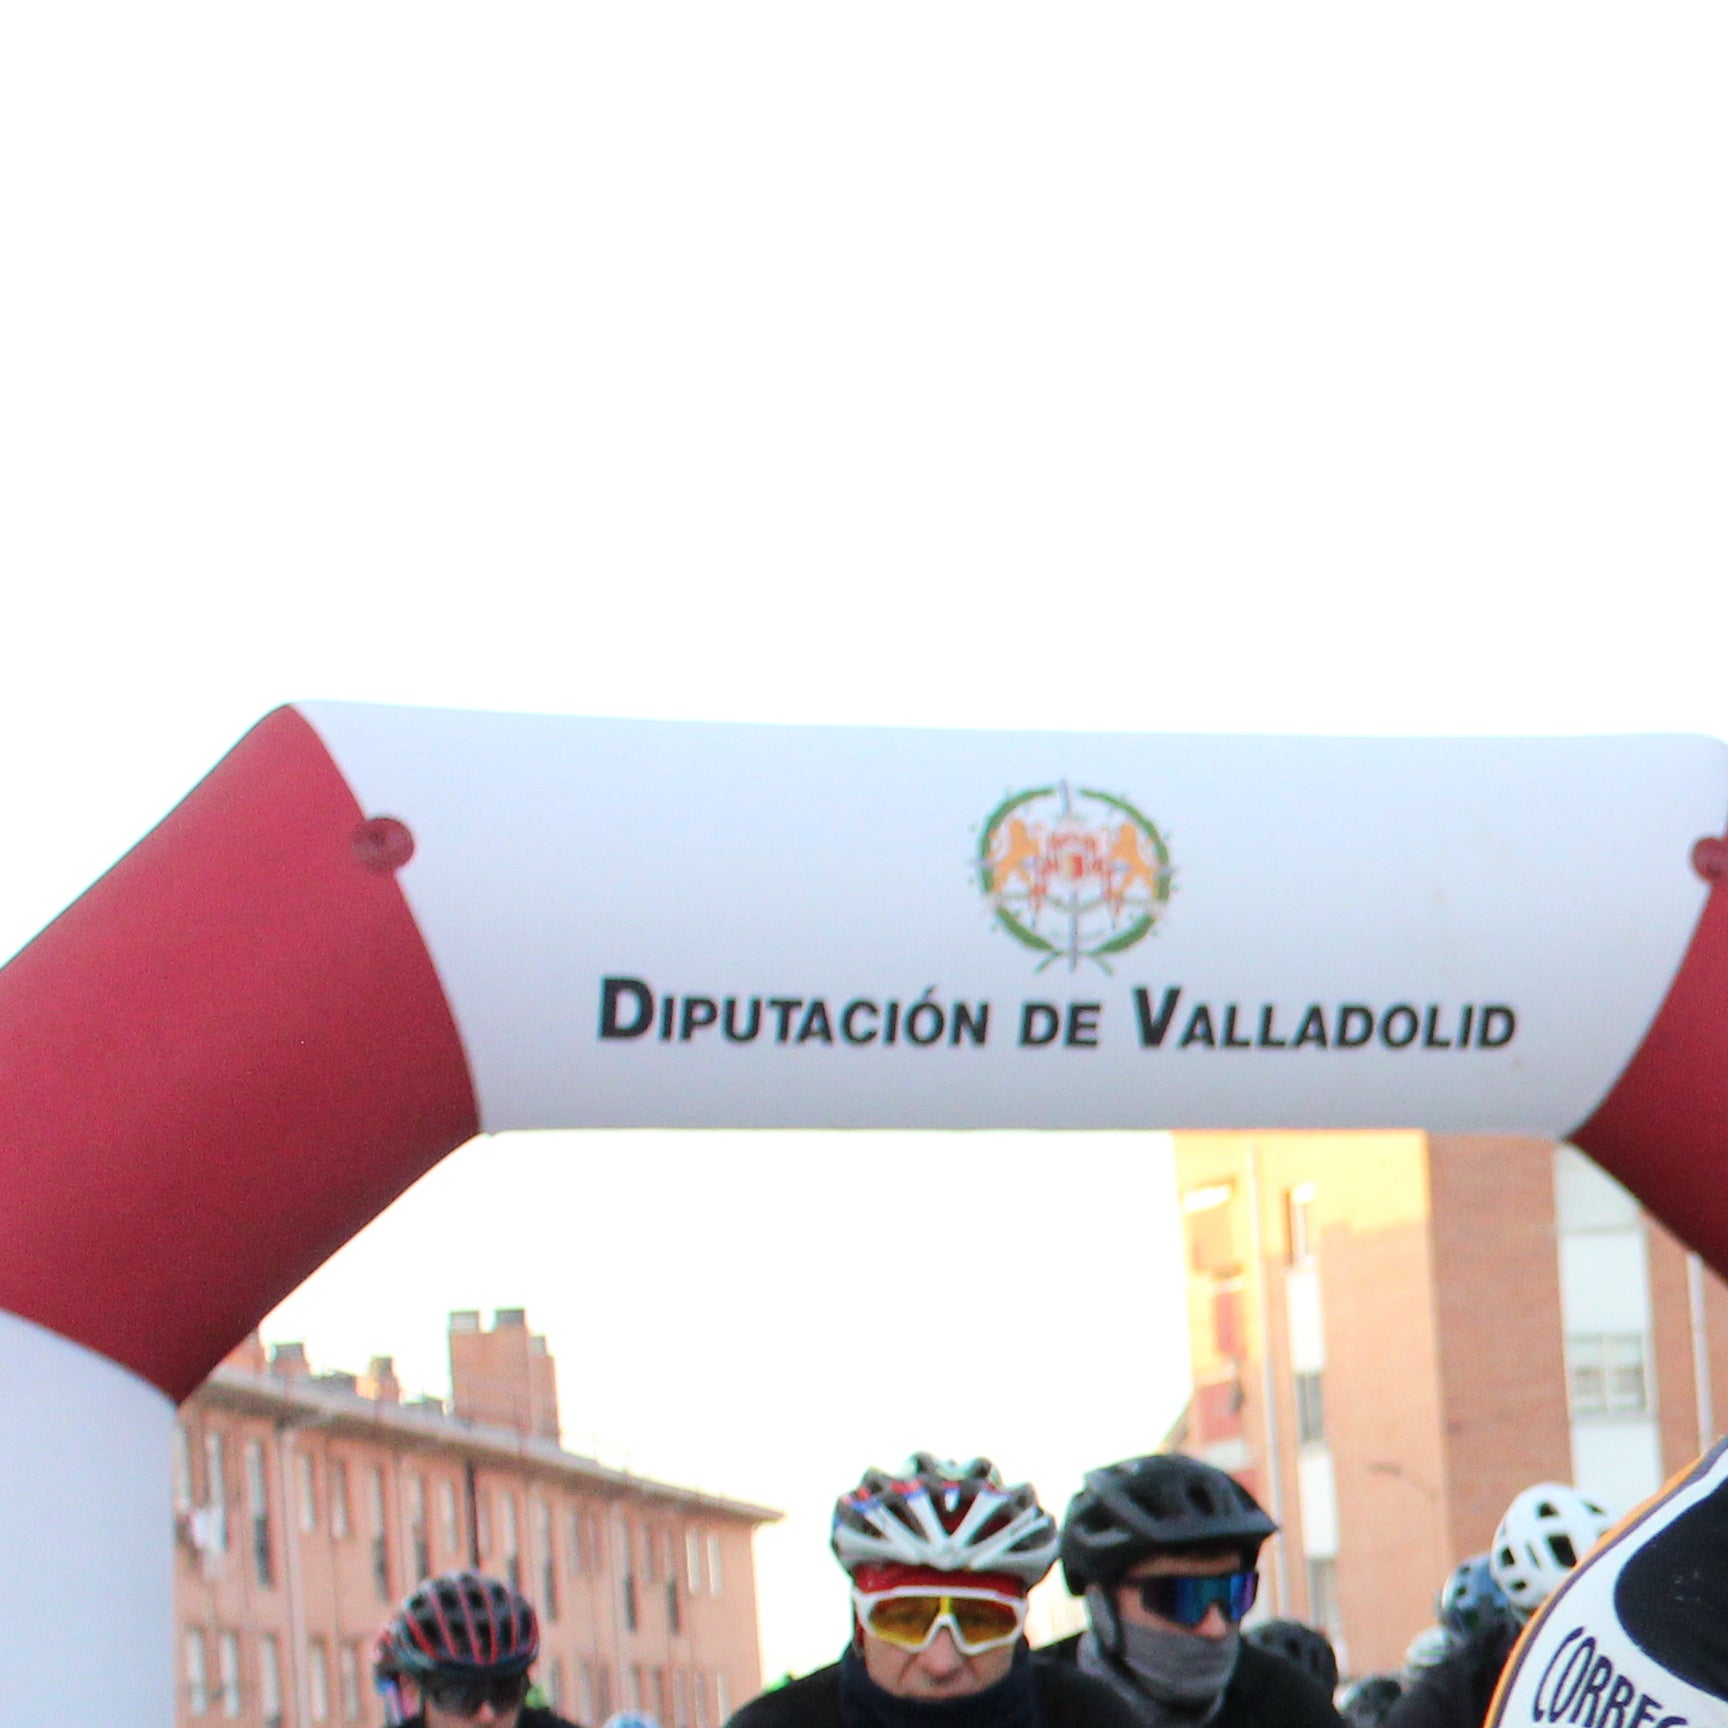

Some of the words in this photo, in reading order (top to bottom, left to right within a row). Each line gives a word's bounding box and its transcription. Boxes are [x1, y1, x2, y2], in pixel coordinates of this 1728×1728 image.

[600, 975, 989, 1047] DIPUTACIÓN
[1019, 1001, 1101, 1048] DE
[1132, 985, 1516, 1049] VALLADOLID
